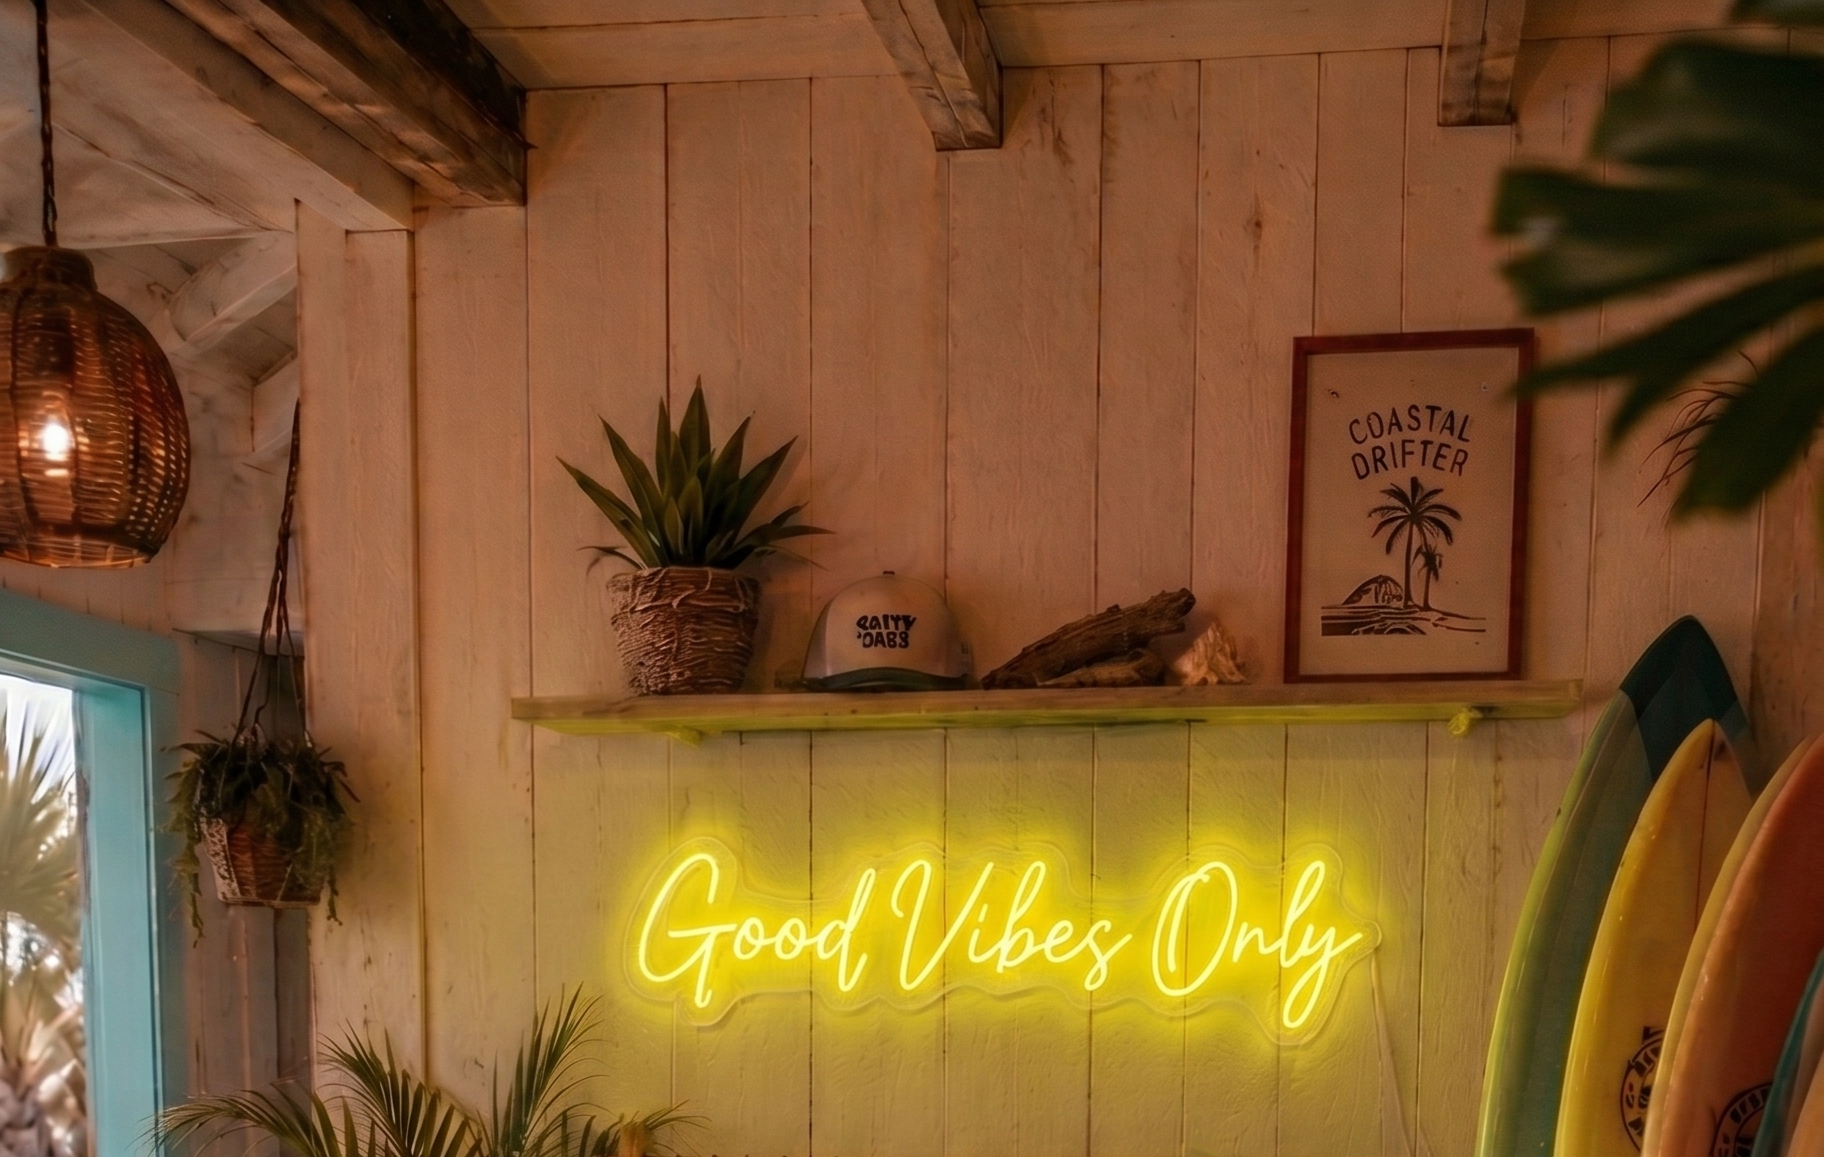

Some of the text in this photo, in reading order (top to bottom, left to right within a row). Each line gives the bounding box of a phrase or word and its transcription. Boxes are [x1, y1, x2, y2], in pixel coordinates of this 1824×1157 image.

[1349, 404, 1470, 444] COASTAL
[1351, 439, 1469, 480] DRIFTER
[637, 851, 1364, 1029] Good Vibes Only
